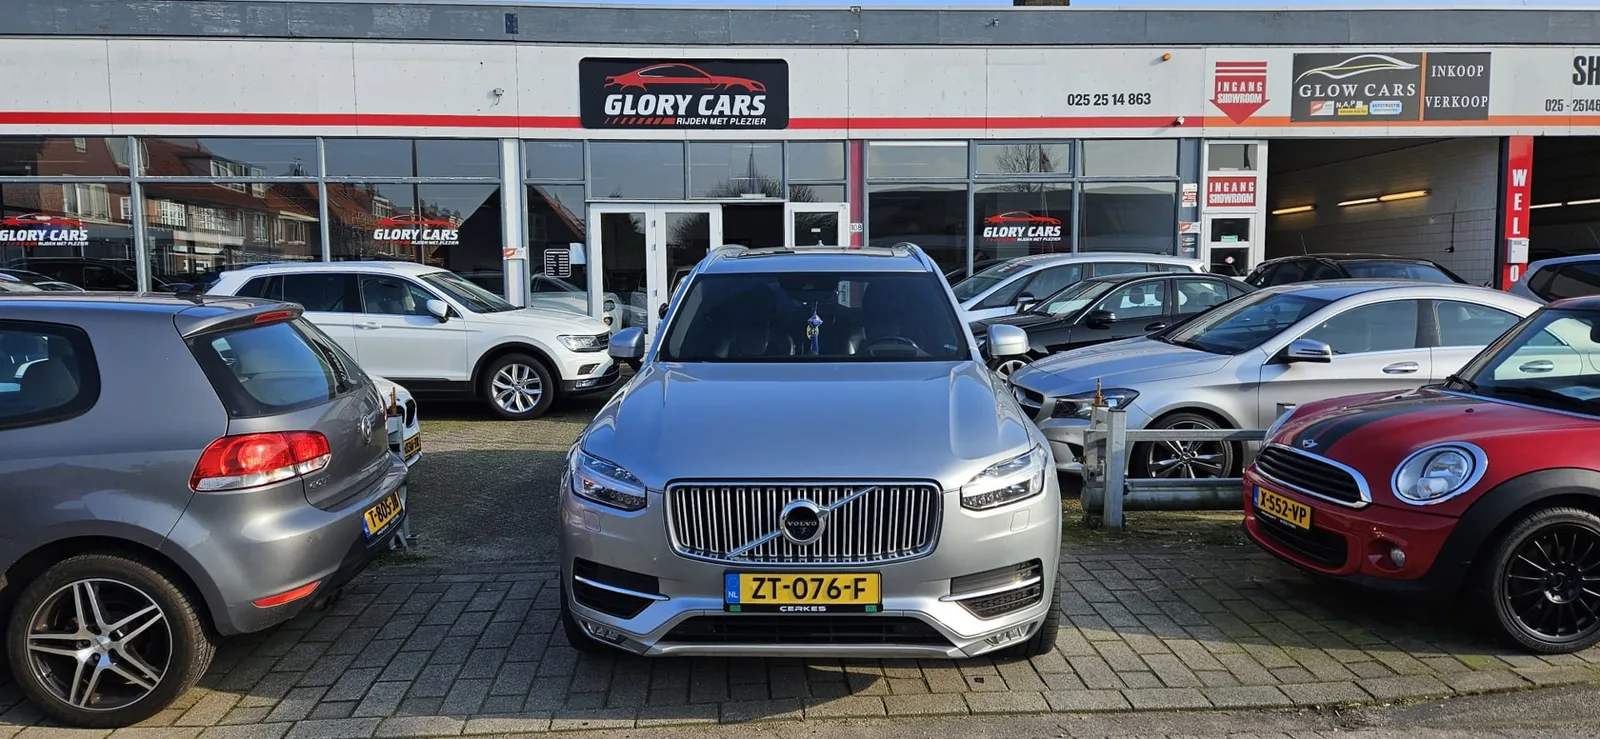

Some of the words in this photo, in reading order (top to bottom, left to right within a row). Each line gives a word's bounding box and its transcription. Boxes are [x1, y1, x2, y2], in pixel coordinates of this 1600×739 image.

[1432, 65, 1484, 78] INKOOP
[1573, 55, 1600, 85] SH
[1217, 81, 1263, 92] INGANG
[1299, 84, 1358, 97] GLOW
[1364, 83, 1416, 97] CARS
[604, 94, 693, 116] GLORY
[698, 94, 767, 116] CARS
[1067, 93, 1090, 106] 025
[1093, 93, 1109, 106] 25
[1112, 93, 1125, 106] 14
[1128, 92, 1152, 105] 863
[1217, 93, 1263, 104] SHOWROOM
[1425, 95, 1488, 108] VERKOOP
[1545, 99, 1564, 112] 025
[676, 117, 708, 126] RIJDEN
[709, 117, 728, 126] MET
[730, 117, 767, 126] PLEZIER
[1209, 182, 1254, 192] INGANG
[1209, 193, 1254, 204] SHOWROOM
[0, 229, 47, 241] GLORY
[49, 229, 88, 241] CARS
[373, 229, 420, 240] GLORY
[422, 229, 459, 240] CARS
[984, 226, 1026, 237] GLORY
[1027, 226, 1061, 237] CARS
[1260, 490, 1307, 523] X-552-VP
[752, 577, 867, 600] ZT-076-F
